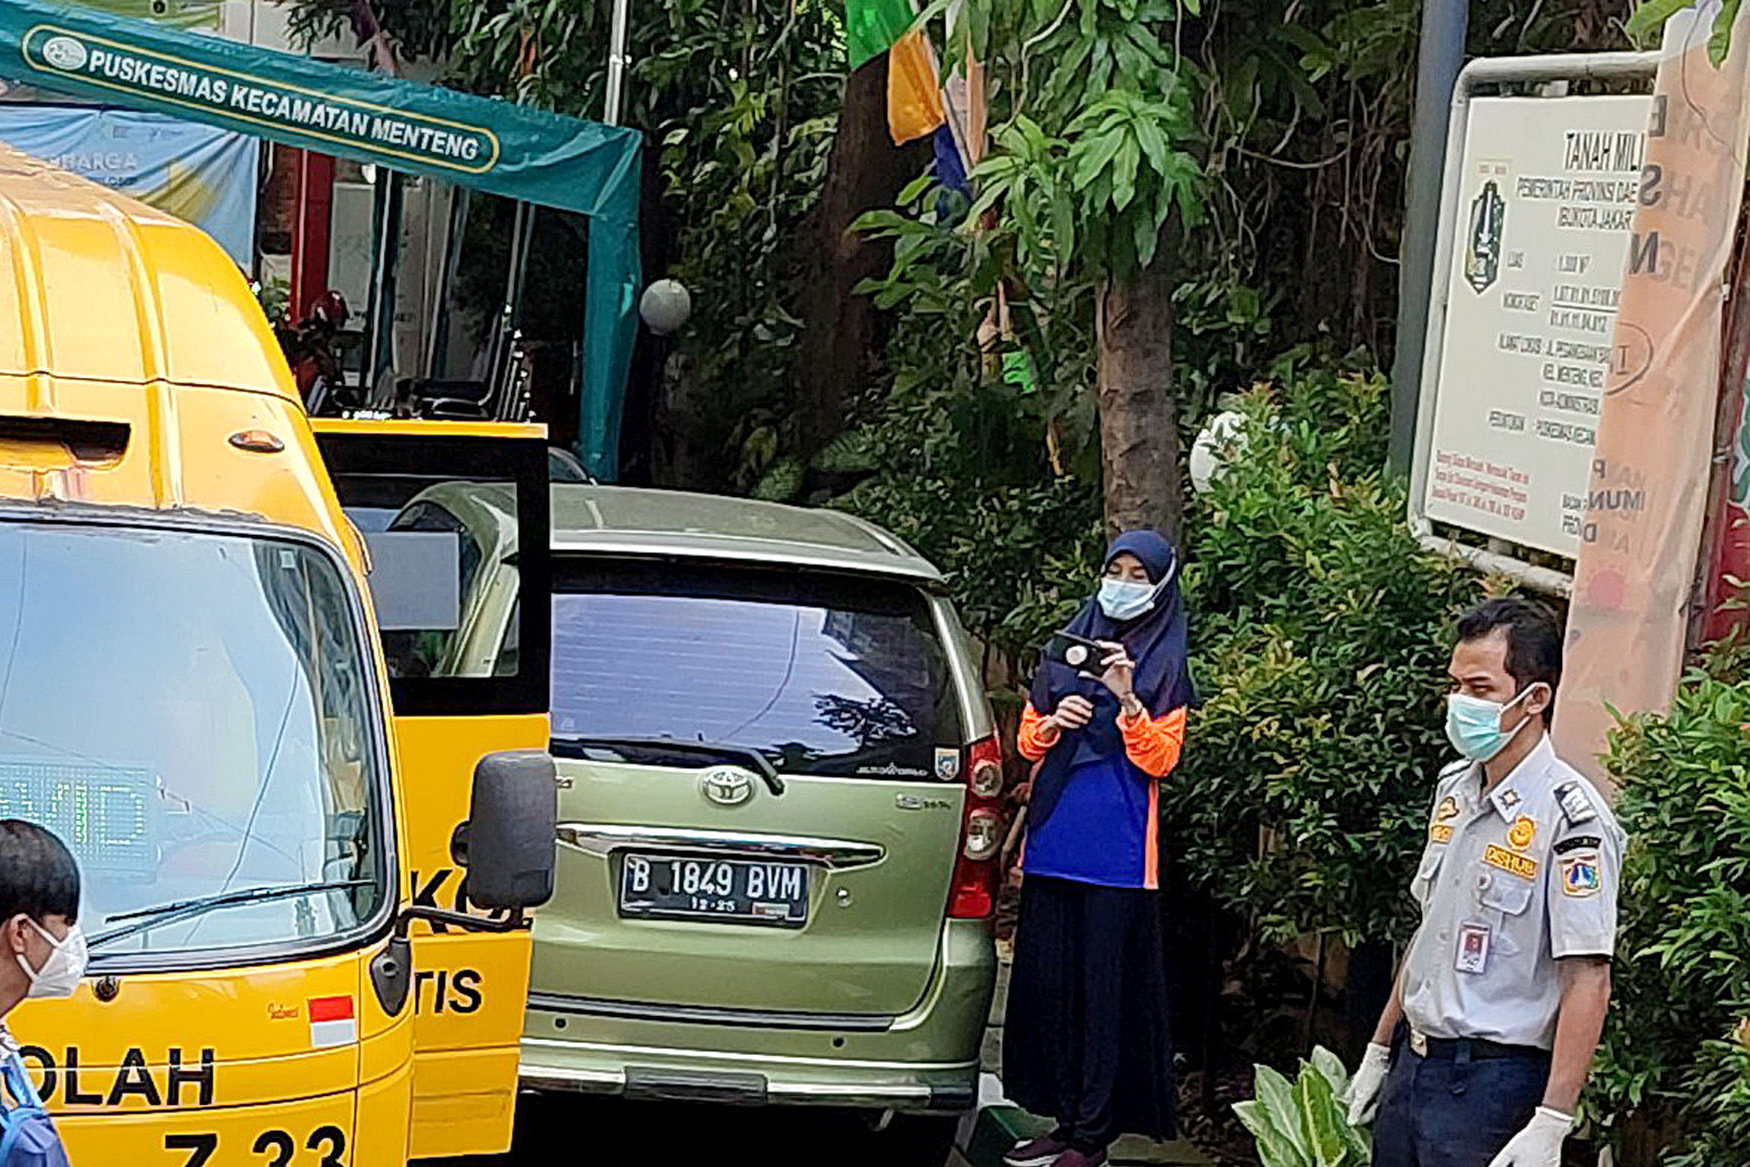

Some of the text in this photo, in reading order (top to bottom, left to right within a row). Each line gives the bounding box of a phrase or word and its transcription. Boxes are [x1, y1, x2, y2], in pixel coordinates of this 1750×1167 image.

[88, 50, 479, 161] PUSKESMAS KECAMATAN MENTENG
[1564, 132, 1612, 170] TANAH
[632, 859, 801, 901] B 1849 BVM
